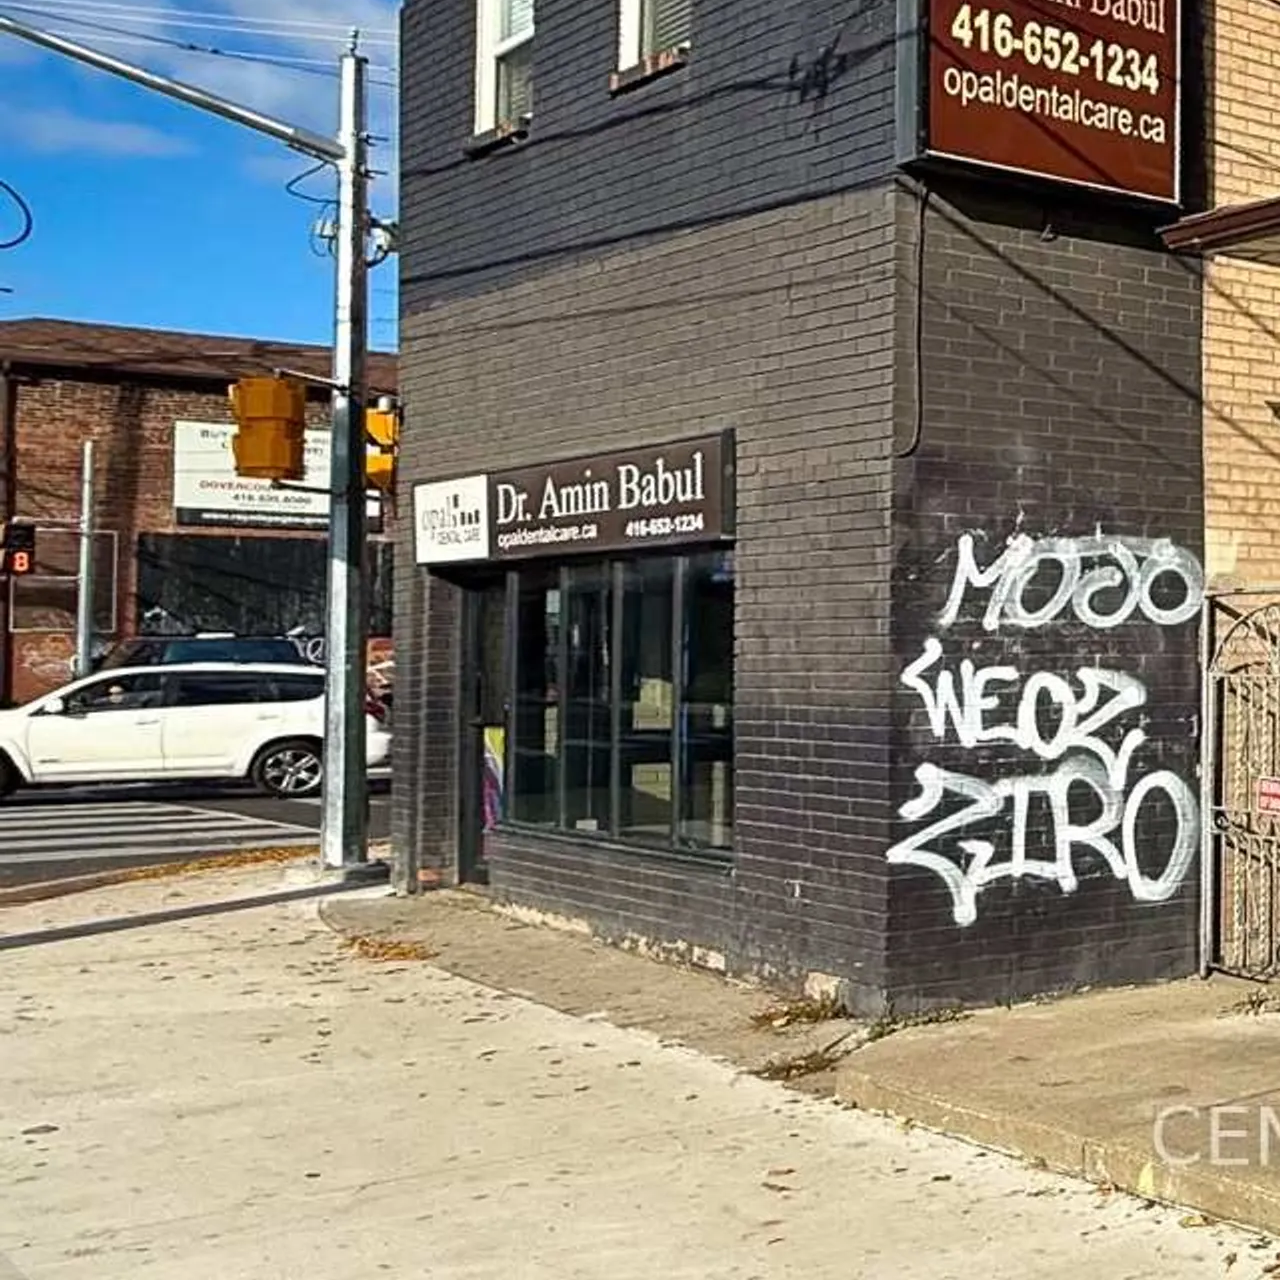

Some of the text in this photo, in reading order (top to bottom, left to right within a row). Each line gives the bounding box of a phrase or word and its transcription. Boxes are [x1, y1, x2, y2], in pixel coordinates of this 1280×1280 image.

[951, 3, 1160, 96] 416-652-1234
[943, 65, 1166, 144] opaldentalcare.ca
[497, 452, 705, 524] Dr. Amin Babul
[498, 523, 598, 550] opaldentalcare.ca
[625, 513, 704, 538] 416-652-1234
[13, 551, 29, 572] 8
